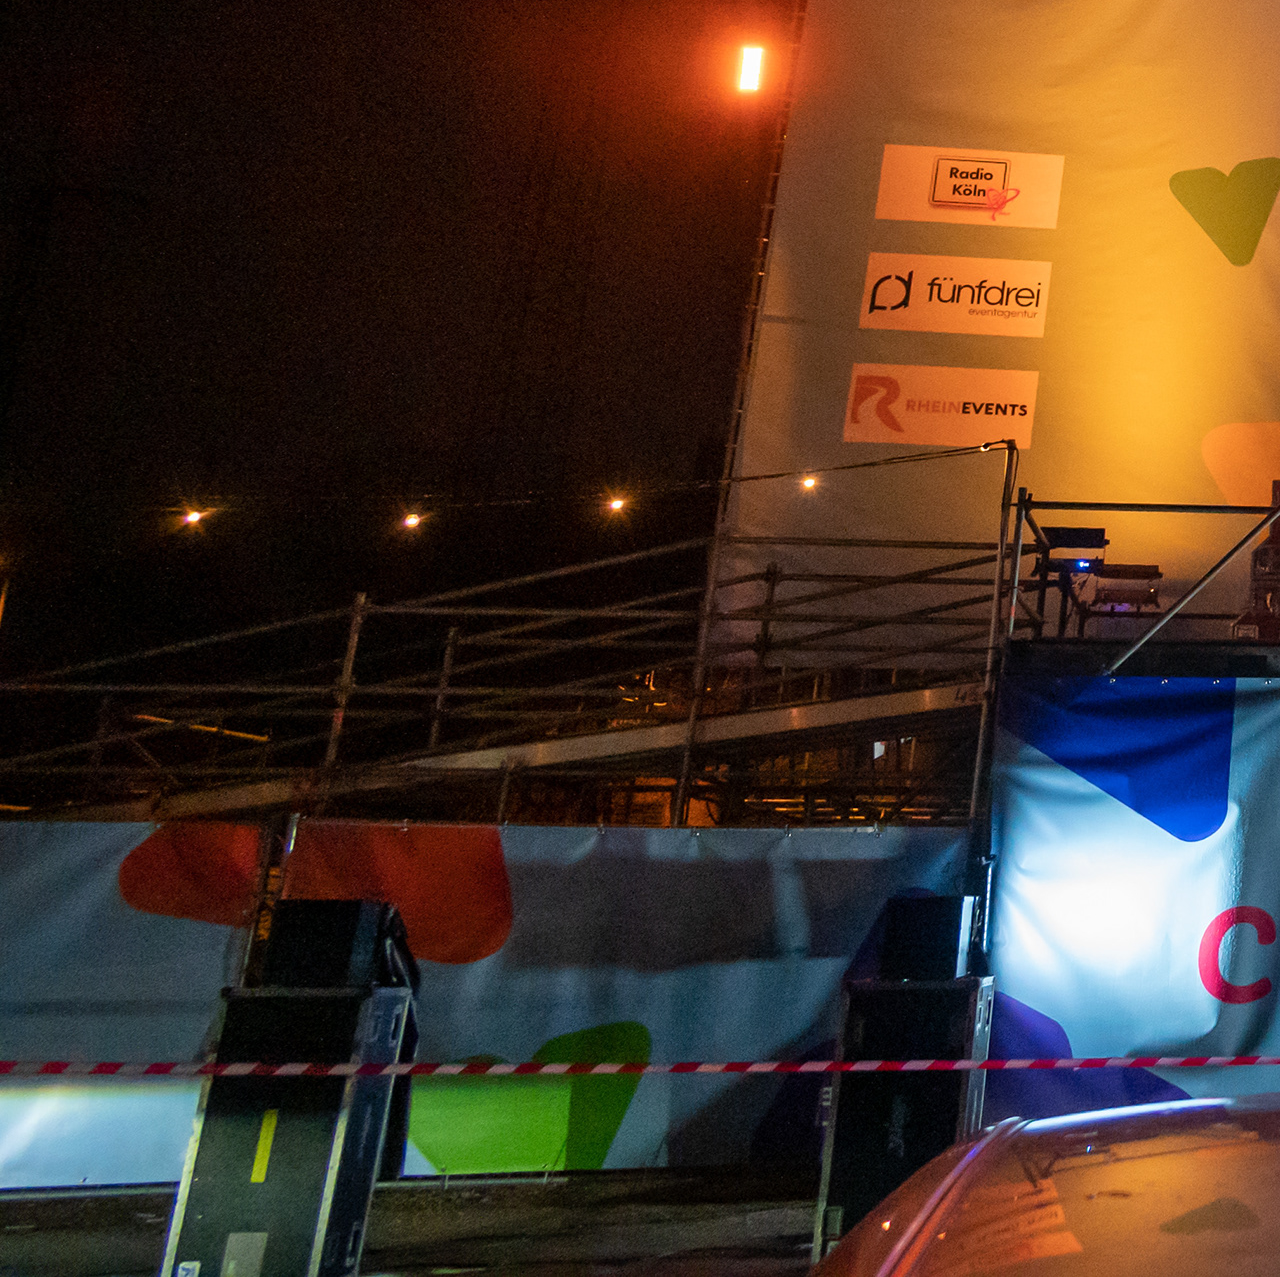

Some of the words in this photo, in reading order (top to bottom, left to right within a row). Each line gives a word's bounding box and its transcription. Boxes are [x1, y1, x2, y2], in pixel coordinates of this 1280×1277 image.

[949, 167, 994, 181] Radio
[952, 184, 987, 197] Köln
[927, 277, 1042, 308] fünfdrei
[968, 308, 1038, 319] eventagentur
[905, 398, 1028, 418] RHEINEVENTS
